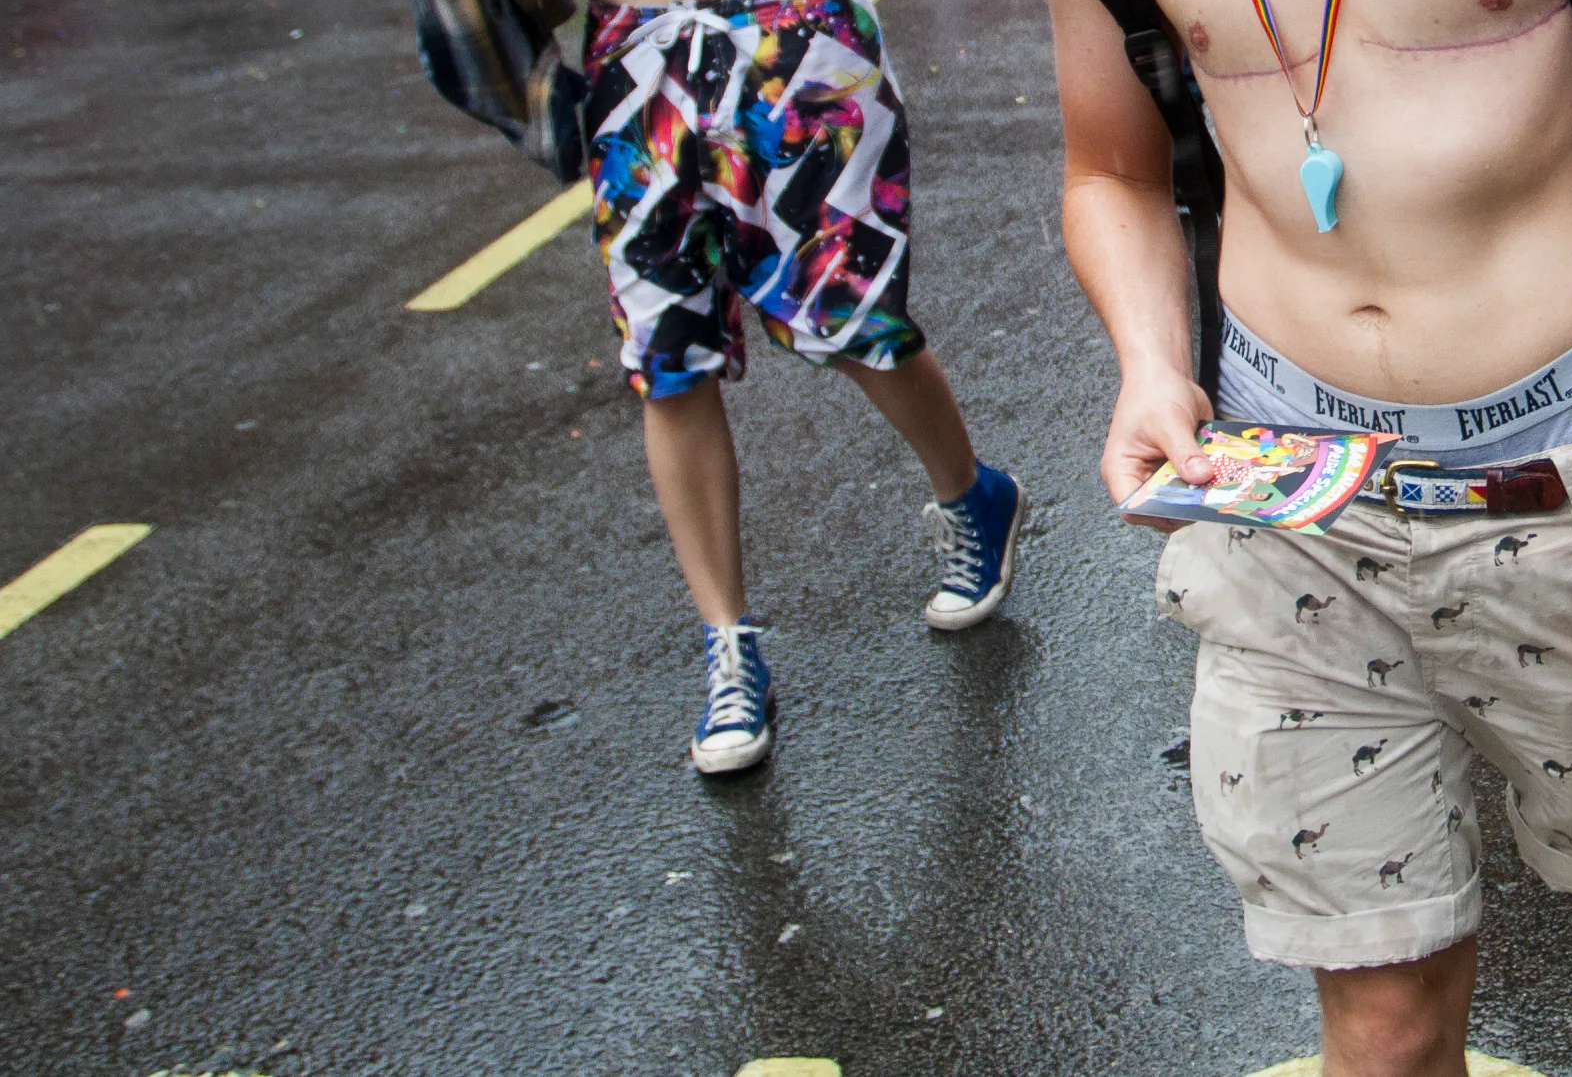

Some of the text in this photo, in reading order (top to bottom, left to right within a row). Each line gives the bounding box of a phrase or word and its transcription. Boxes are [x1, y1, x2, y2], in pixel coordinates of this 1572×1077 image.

[1223, 316, 1279, 387] VERLAST
[1313, 383, 1406, 442] EVERLAST
[1455, 369, 1566, 441] EVERLAST
[1270, 443, 1346, 517] PRIDE SPECIAL
